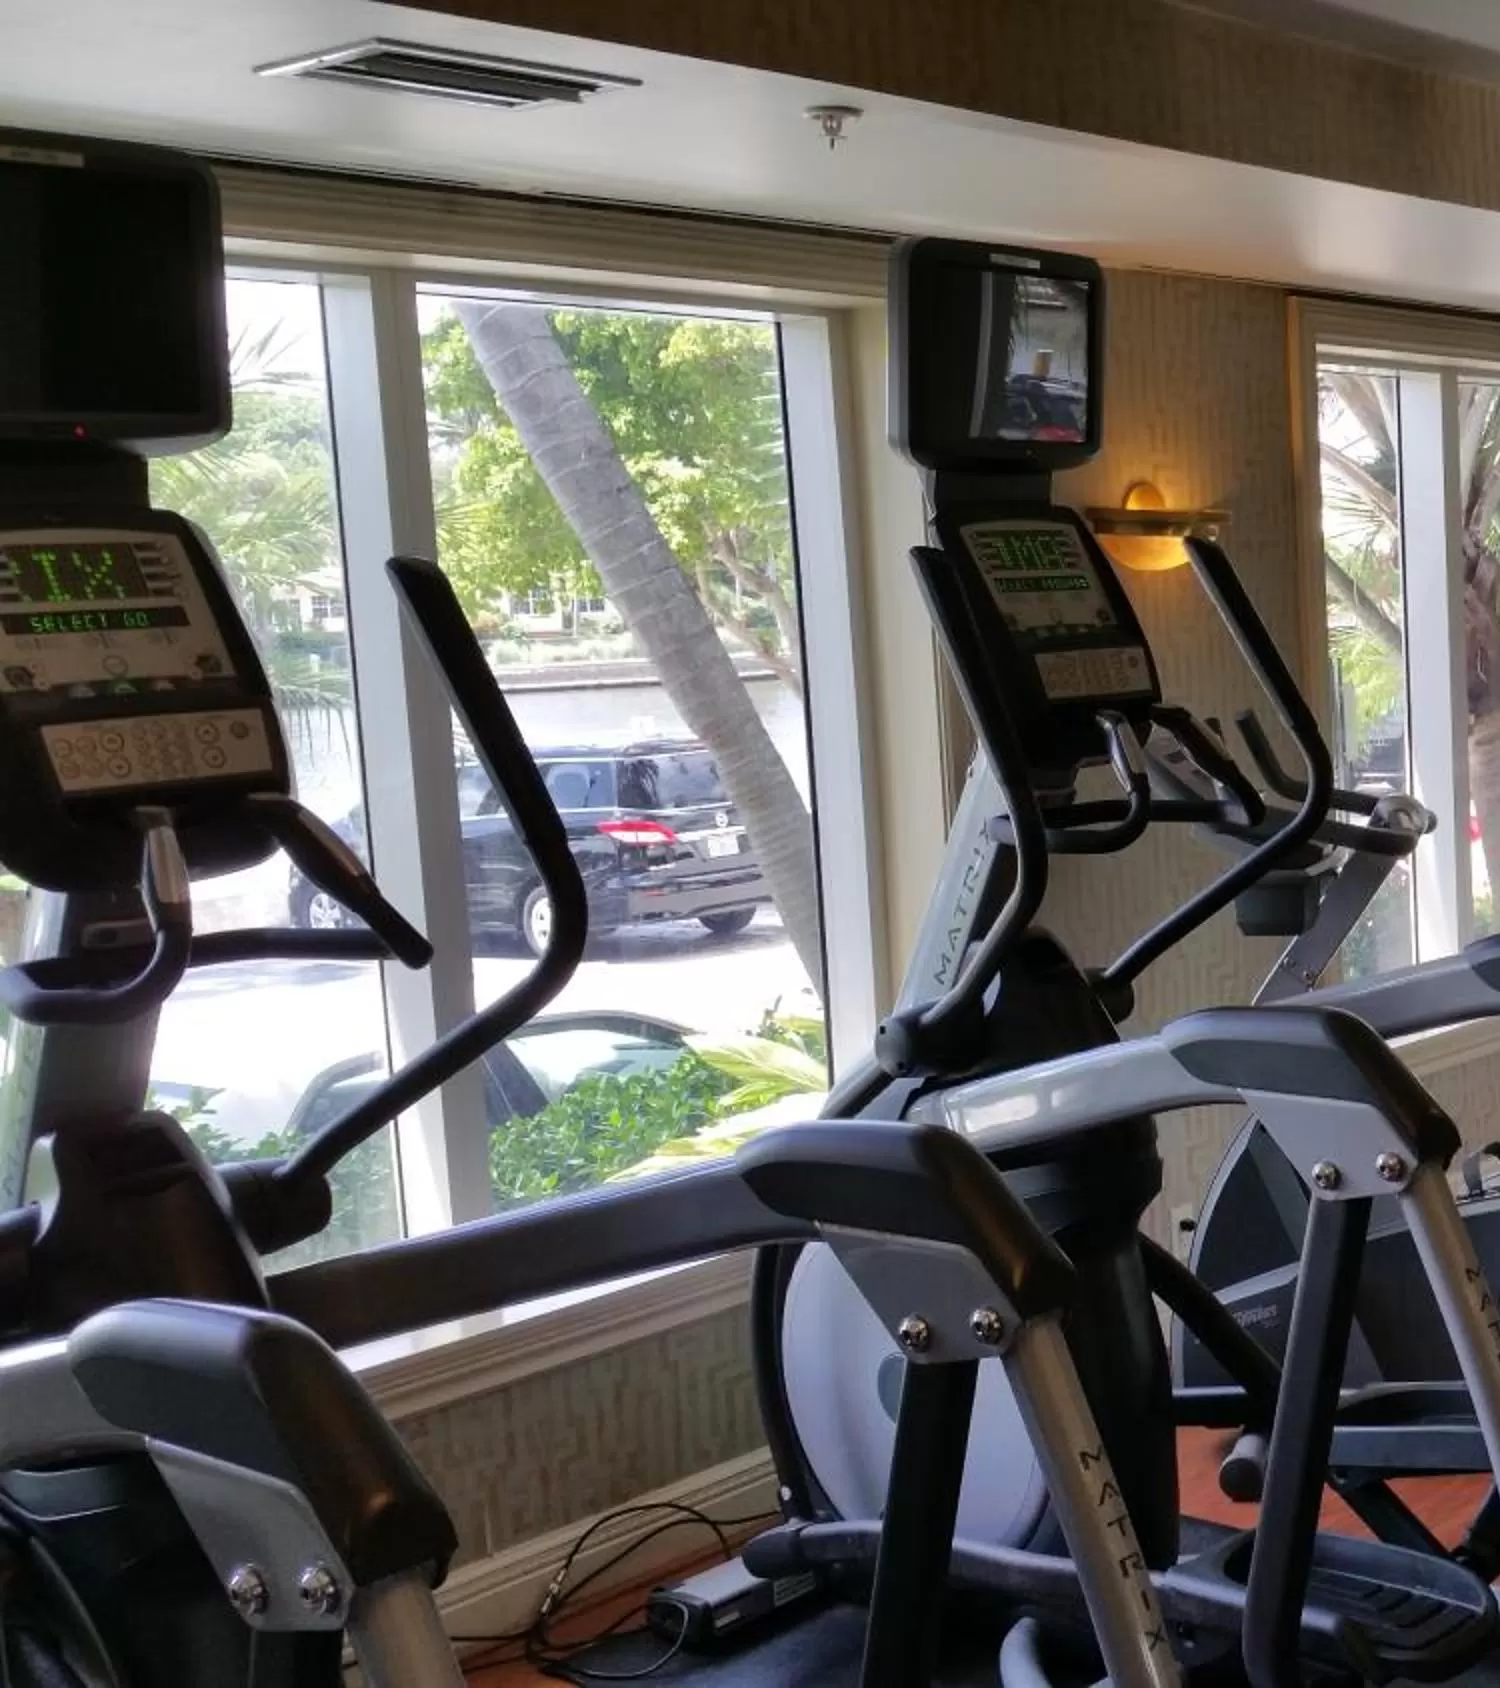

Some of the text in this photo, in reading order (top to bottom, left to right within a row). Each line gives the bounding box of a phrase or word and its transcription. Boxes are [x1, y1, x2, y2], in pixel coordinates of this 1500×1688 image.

[30, 613, 109, 633] SELECT
[933, 816, 990, 986] MATRIX
[1079, 1447, 1166, 1651] MATRIX
